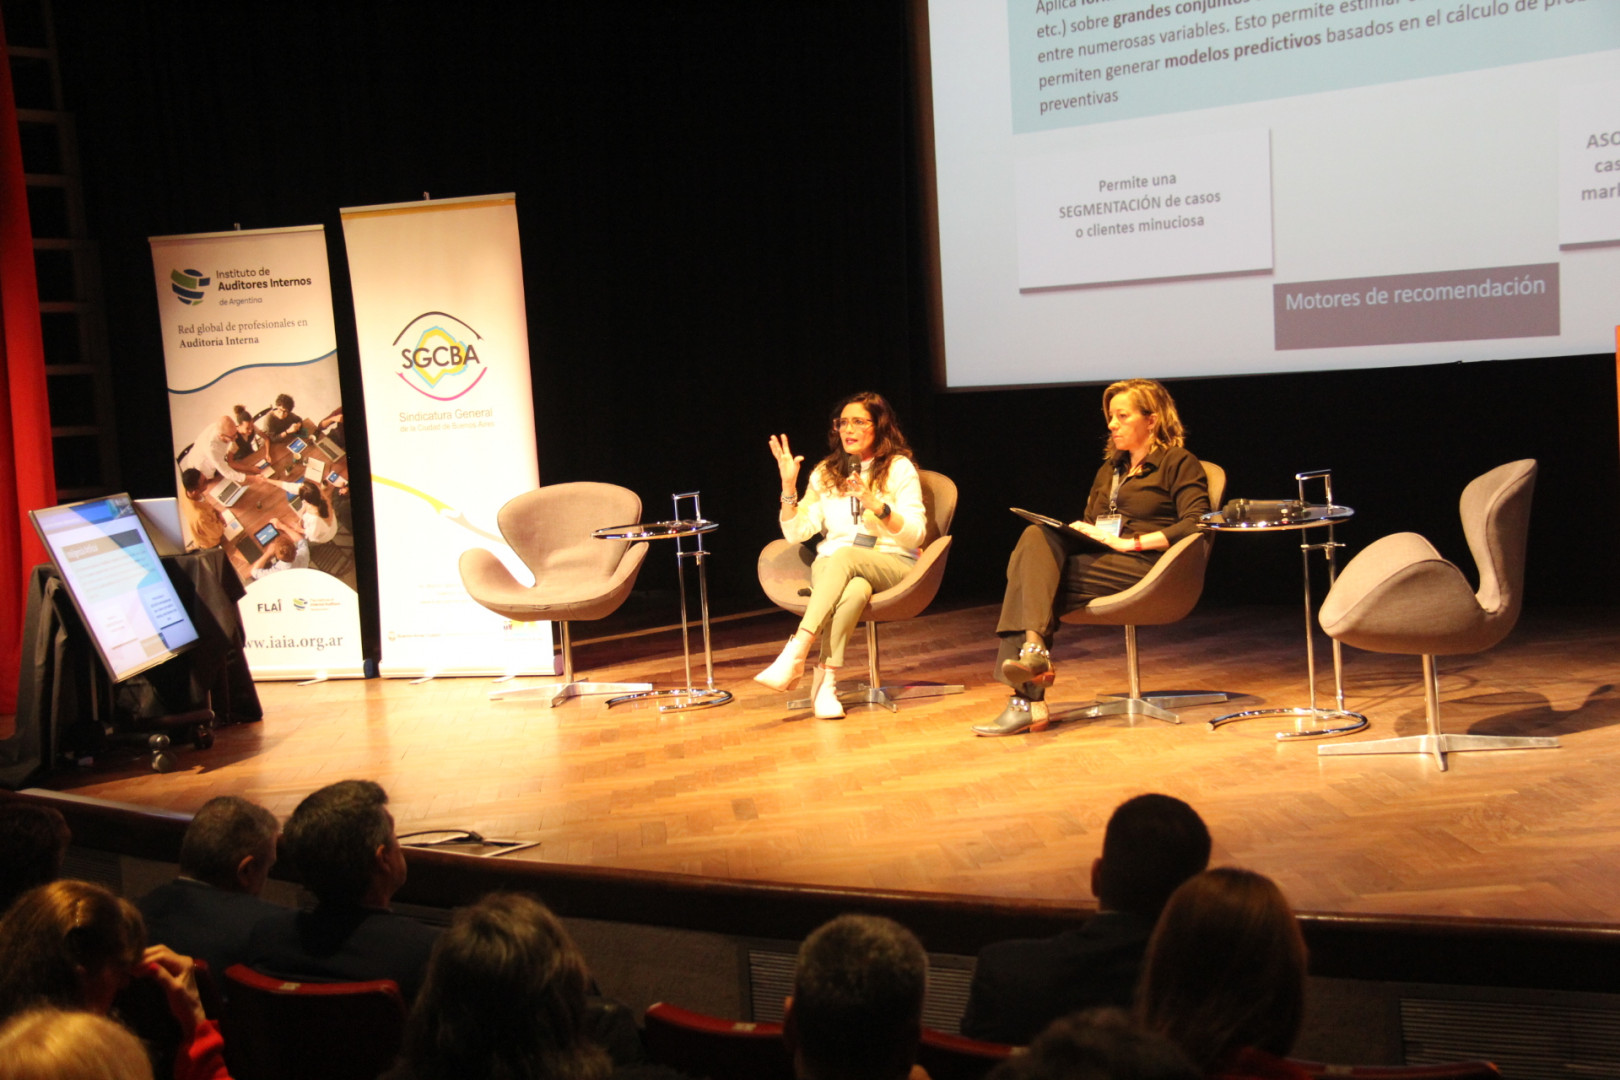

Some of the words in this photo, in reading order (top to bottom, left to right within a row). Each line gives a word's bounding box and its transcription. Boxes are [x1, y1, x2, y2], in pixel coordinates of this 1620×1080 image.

[1037, 19, 1067, 38] etc.)
[1071, 16, 1109, 33] sobre
[1113, 4, 1171, 28] grandes
[1175, 0, 1251, 14] conjun
[1038, 46, 1074, 63] entre
[1078, 33, 1156, 57] numerosas
[1160, 20, 1230, 44] variables.
[1235, 15, 1267, 31] Esto
[1272, 3, 1334, 28] permite
[1038, 66, 1102, 91] permiten
[1105, 58, 1160, 81] generar
[1164, 46, 1229, 69] modelos
[1234, 32, 1322, 61] predictivos
[1326, 20, 1394, 43] basados
[1399, 17, 1420, 31] en
[1426, 9, 1441, 27] el
[1446, 0, 1509, 23] cálculo
[1515, 0, 1538, 12] de
[1039, 89, 1119, 115] preventivas
[1098, 175, 1149, 192] Permite
[1152, 174, 1177, 187] una
[1058, 194, 1162, 219] SEGMENTACIÓN
[1165, 193, 1182, 208] de
[1185, 191, 1221, 206] casos
[1075, 226, 1084, 238] o
[1087, 222, 1135, 238] clientes
[1138, 214, 1205, 232] minuciosa
[216, 268, 257, 279] Instituto
[258, 267, 271, 276] de
[218, 279, 269, 291] Auditores
[270, 276, 312, 288] Internos
[219, 298, 228, 306] de
[229, 296, 263, 307] Argentina
[1285, 291, 1361, 311] Motores
[1365, 285, 1390, 305] de
[1394, 274, 1546, 304] recomendación
[178, 324, 196, 335] Red
[197, 322, 224, 336] global
[225, 321, 237, 331] de
[238, 318, 296, 333] profesionales
[297, 318, 308, 327] en
[226, 335, 259, 346] Interna
[401, 344, 480, 369] SGCBA
[399, 410, 452, 422] Sindicatura
[454, 408, 493, 419] General
